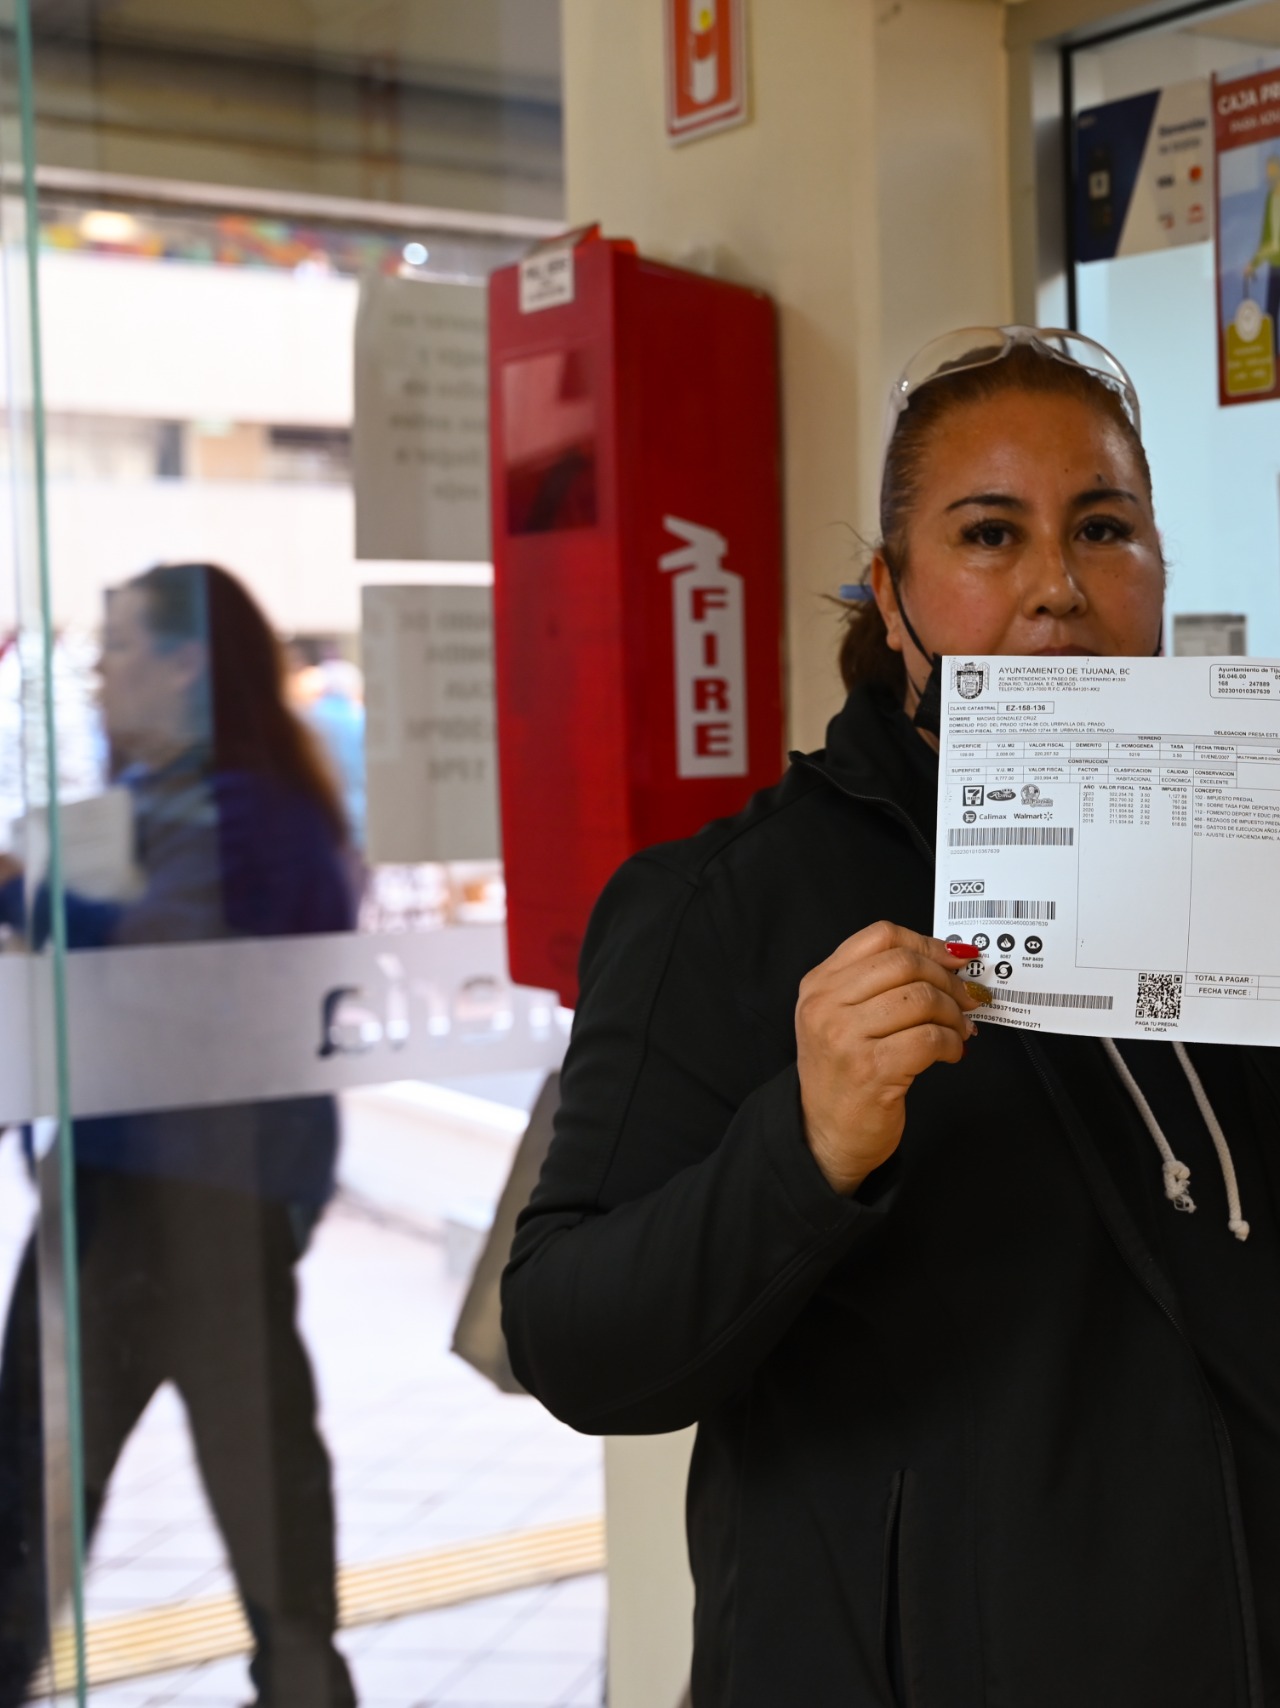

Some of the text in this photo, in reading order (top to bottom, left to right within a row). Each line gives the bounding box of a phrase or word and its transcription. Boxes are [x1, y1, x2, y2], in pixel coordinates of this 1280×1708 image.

[1218, 89, 1258, 115] CAJA
[691, 587, 732, 758] FIRE
[950, 882, 984, 894] OXXO
[1199, 987, 1248, 996] FECHA VENCE
